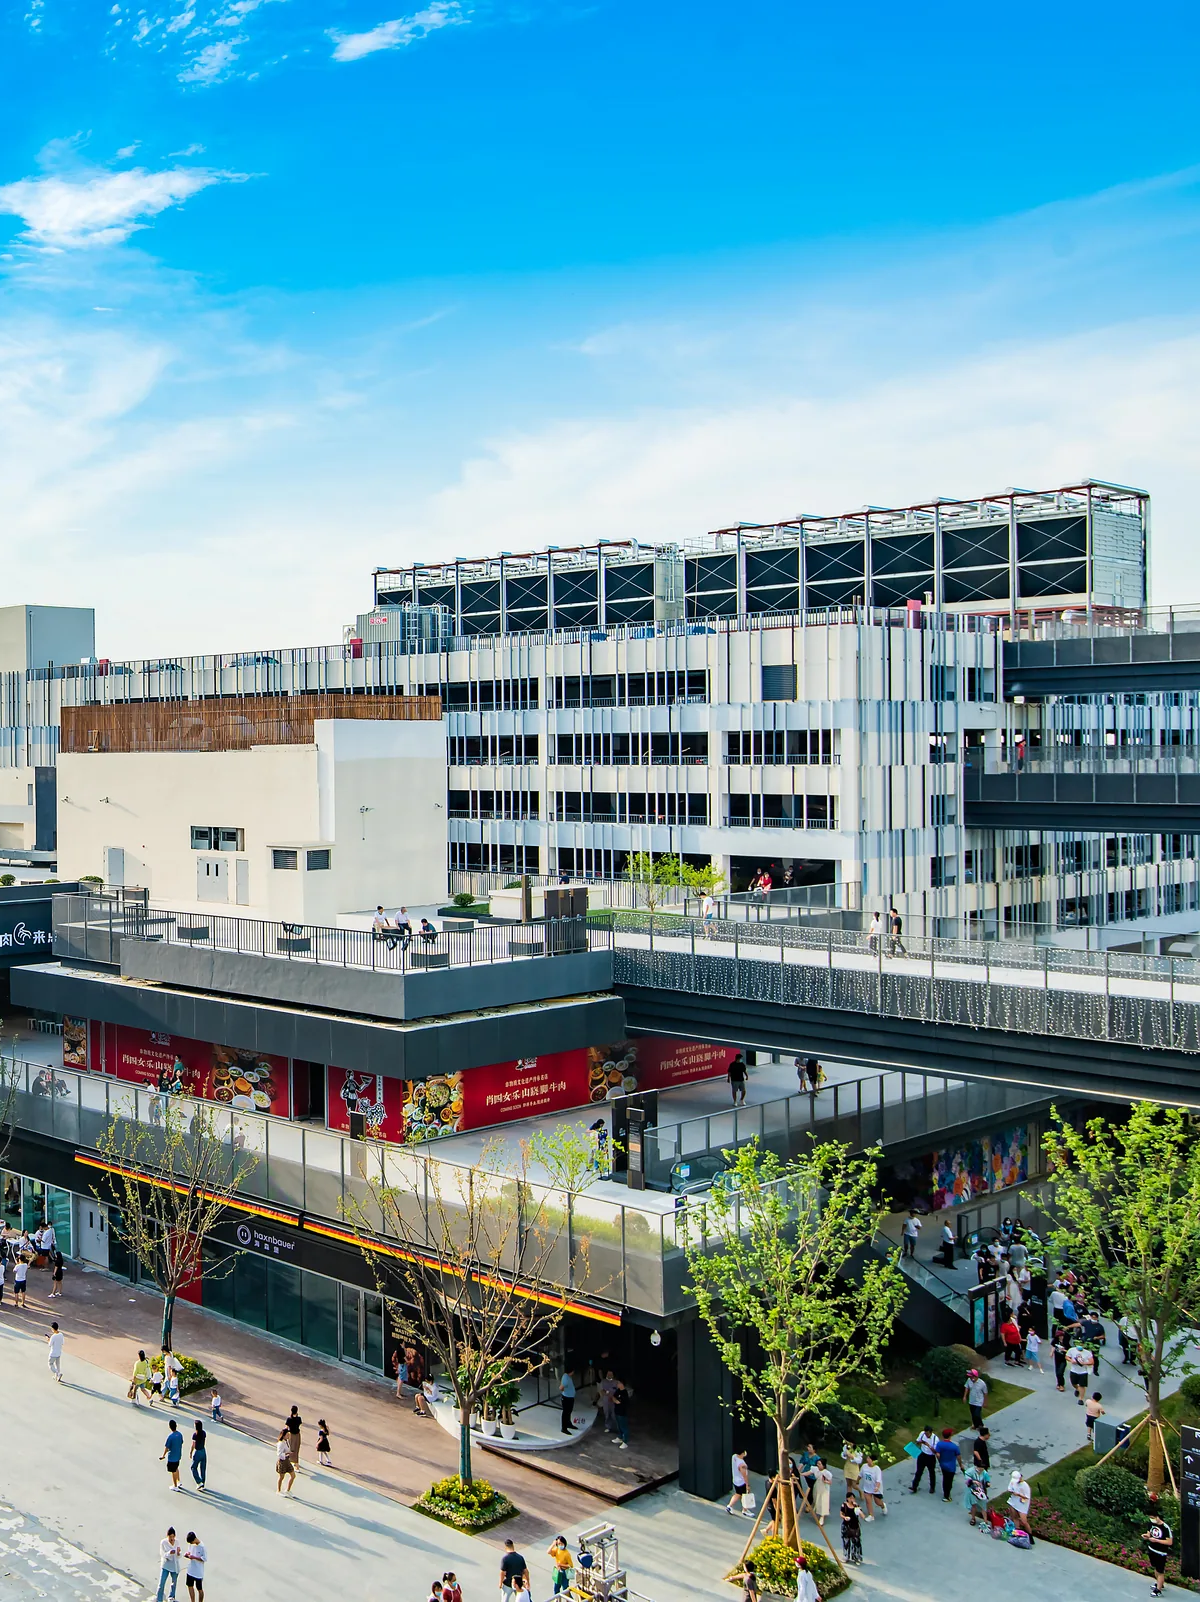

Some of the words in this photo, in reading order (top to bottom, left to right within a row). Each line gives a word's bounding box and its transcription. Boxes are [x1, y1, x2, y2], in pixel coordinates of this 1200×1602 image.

[122, 1053, 201, 1080] 肖四女乐山跷牛肉
